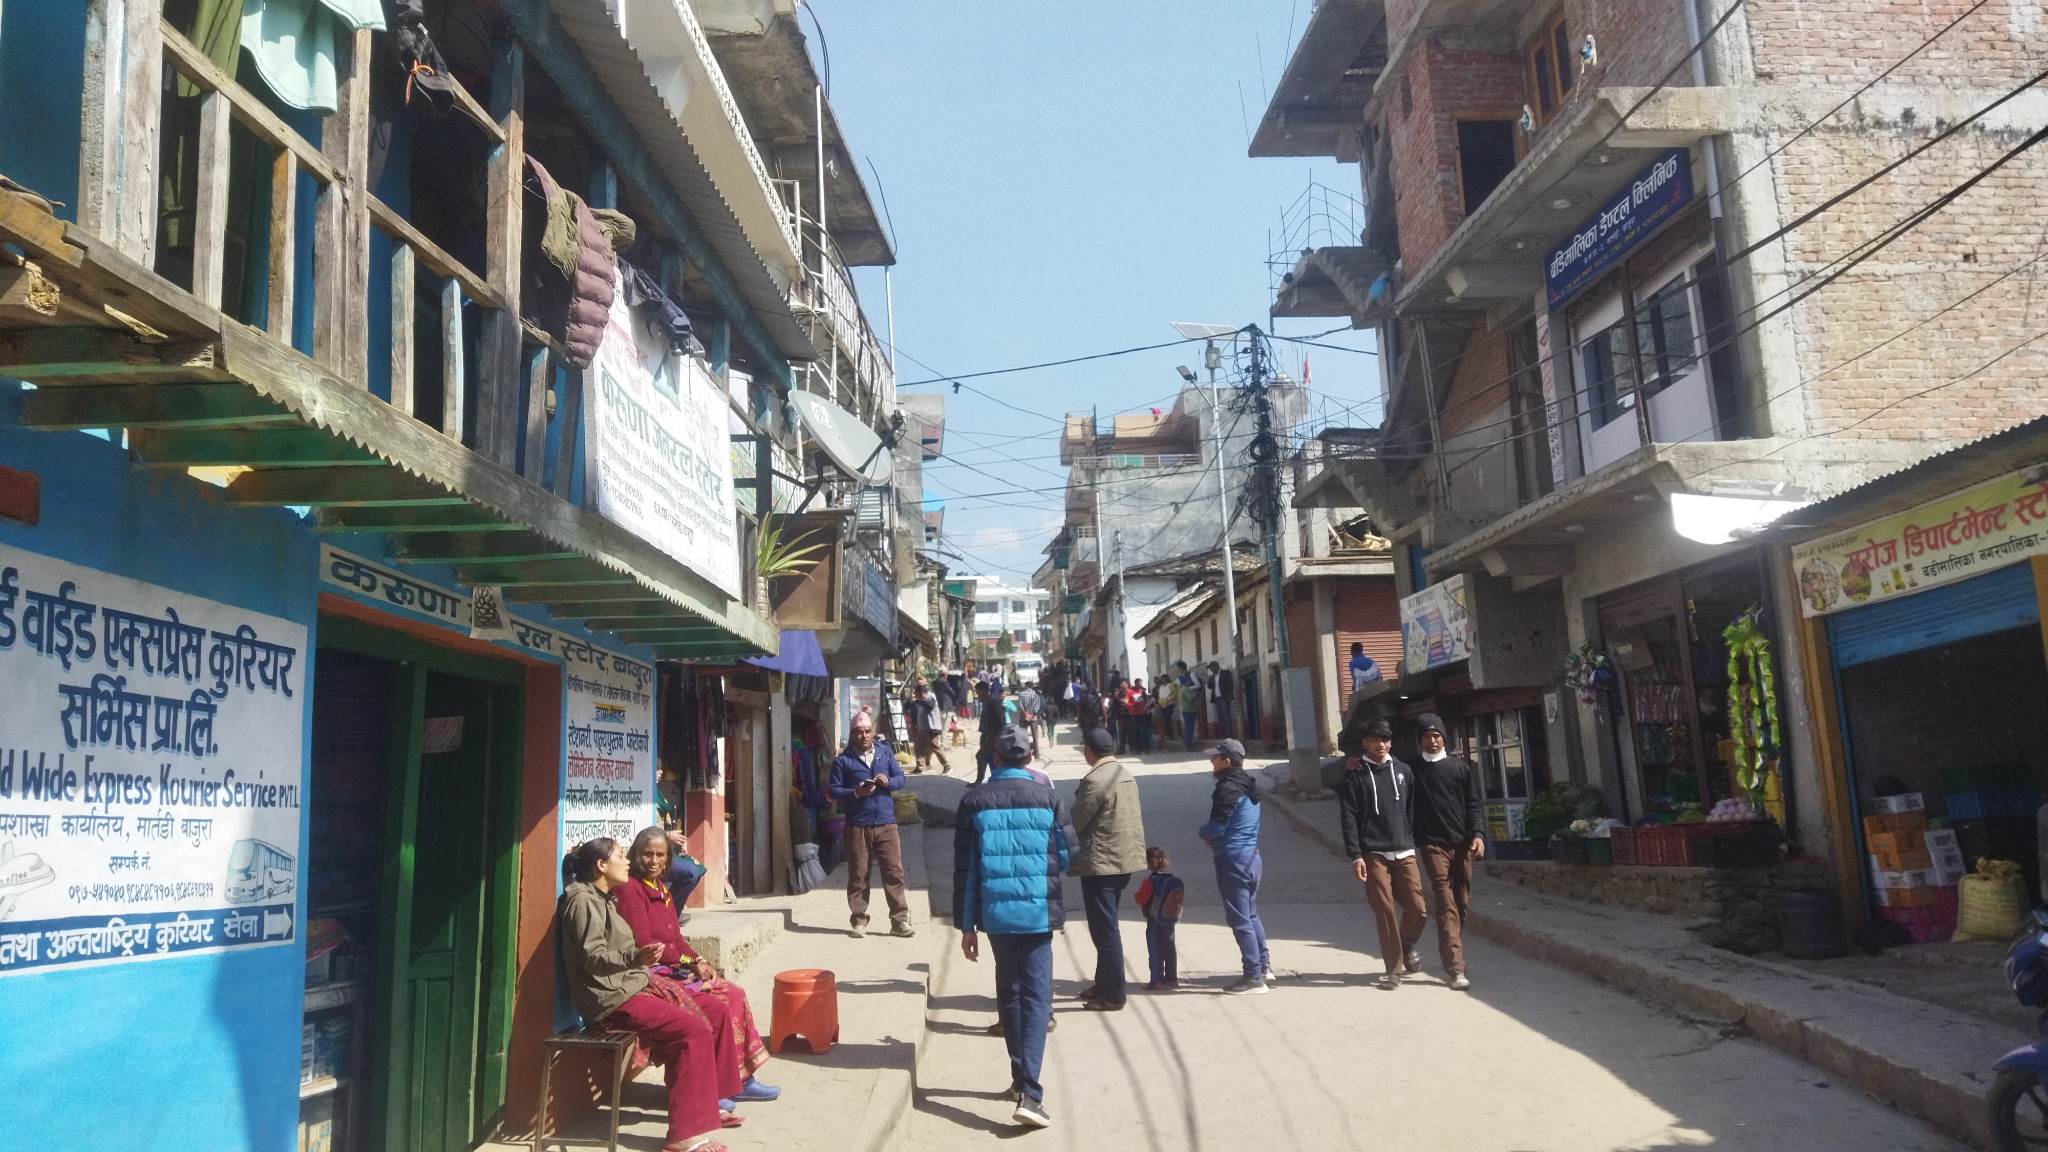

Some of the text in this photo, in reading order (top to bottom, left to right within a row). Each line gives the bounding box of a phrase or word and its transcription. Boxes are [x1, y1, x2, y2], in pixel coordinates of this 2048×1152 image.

[22, 581, 96, 670] वाईड
[101, 606, 207, 683] एक्सप्रेस
[208, 624, 297, 699] कुरियर
[59, 673, 151, 750] सर्भिस
[22, 751, 77, 801] Wide
[84, 755, 152, 814] Express
[160, 763, 221, 807] Kourier
[223, 768, 277, 808] Service
[181, 818, 213, 848] बाजुरा
[108, 850, 139, 875] सम्पर्क
[0, 931, 42, 965] तथा
[155, 913, 215, 954] कुरियर
[223, 911, 258, 939] सेवा
